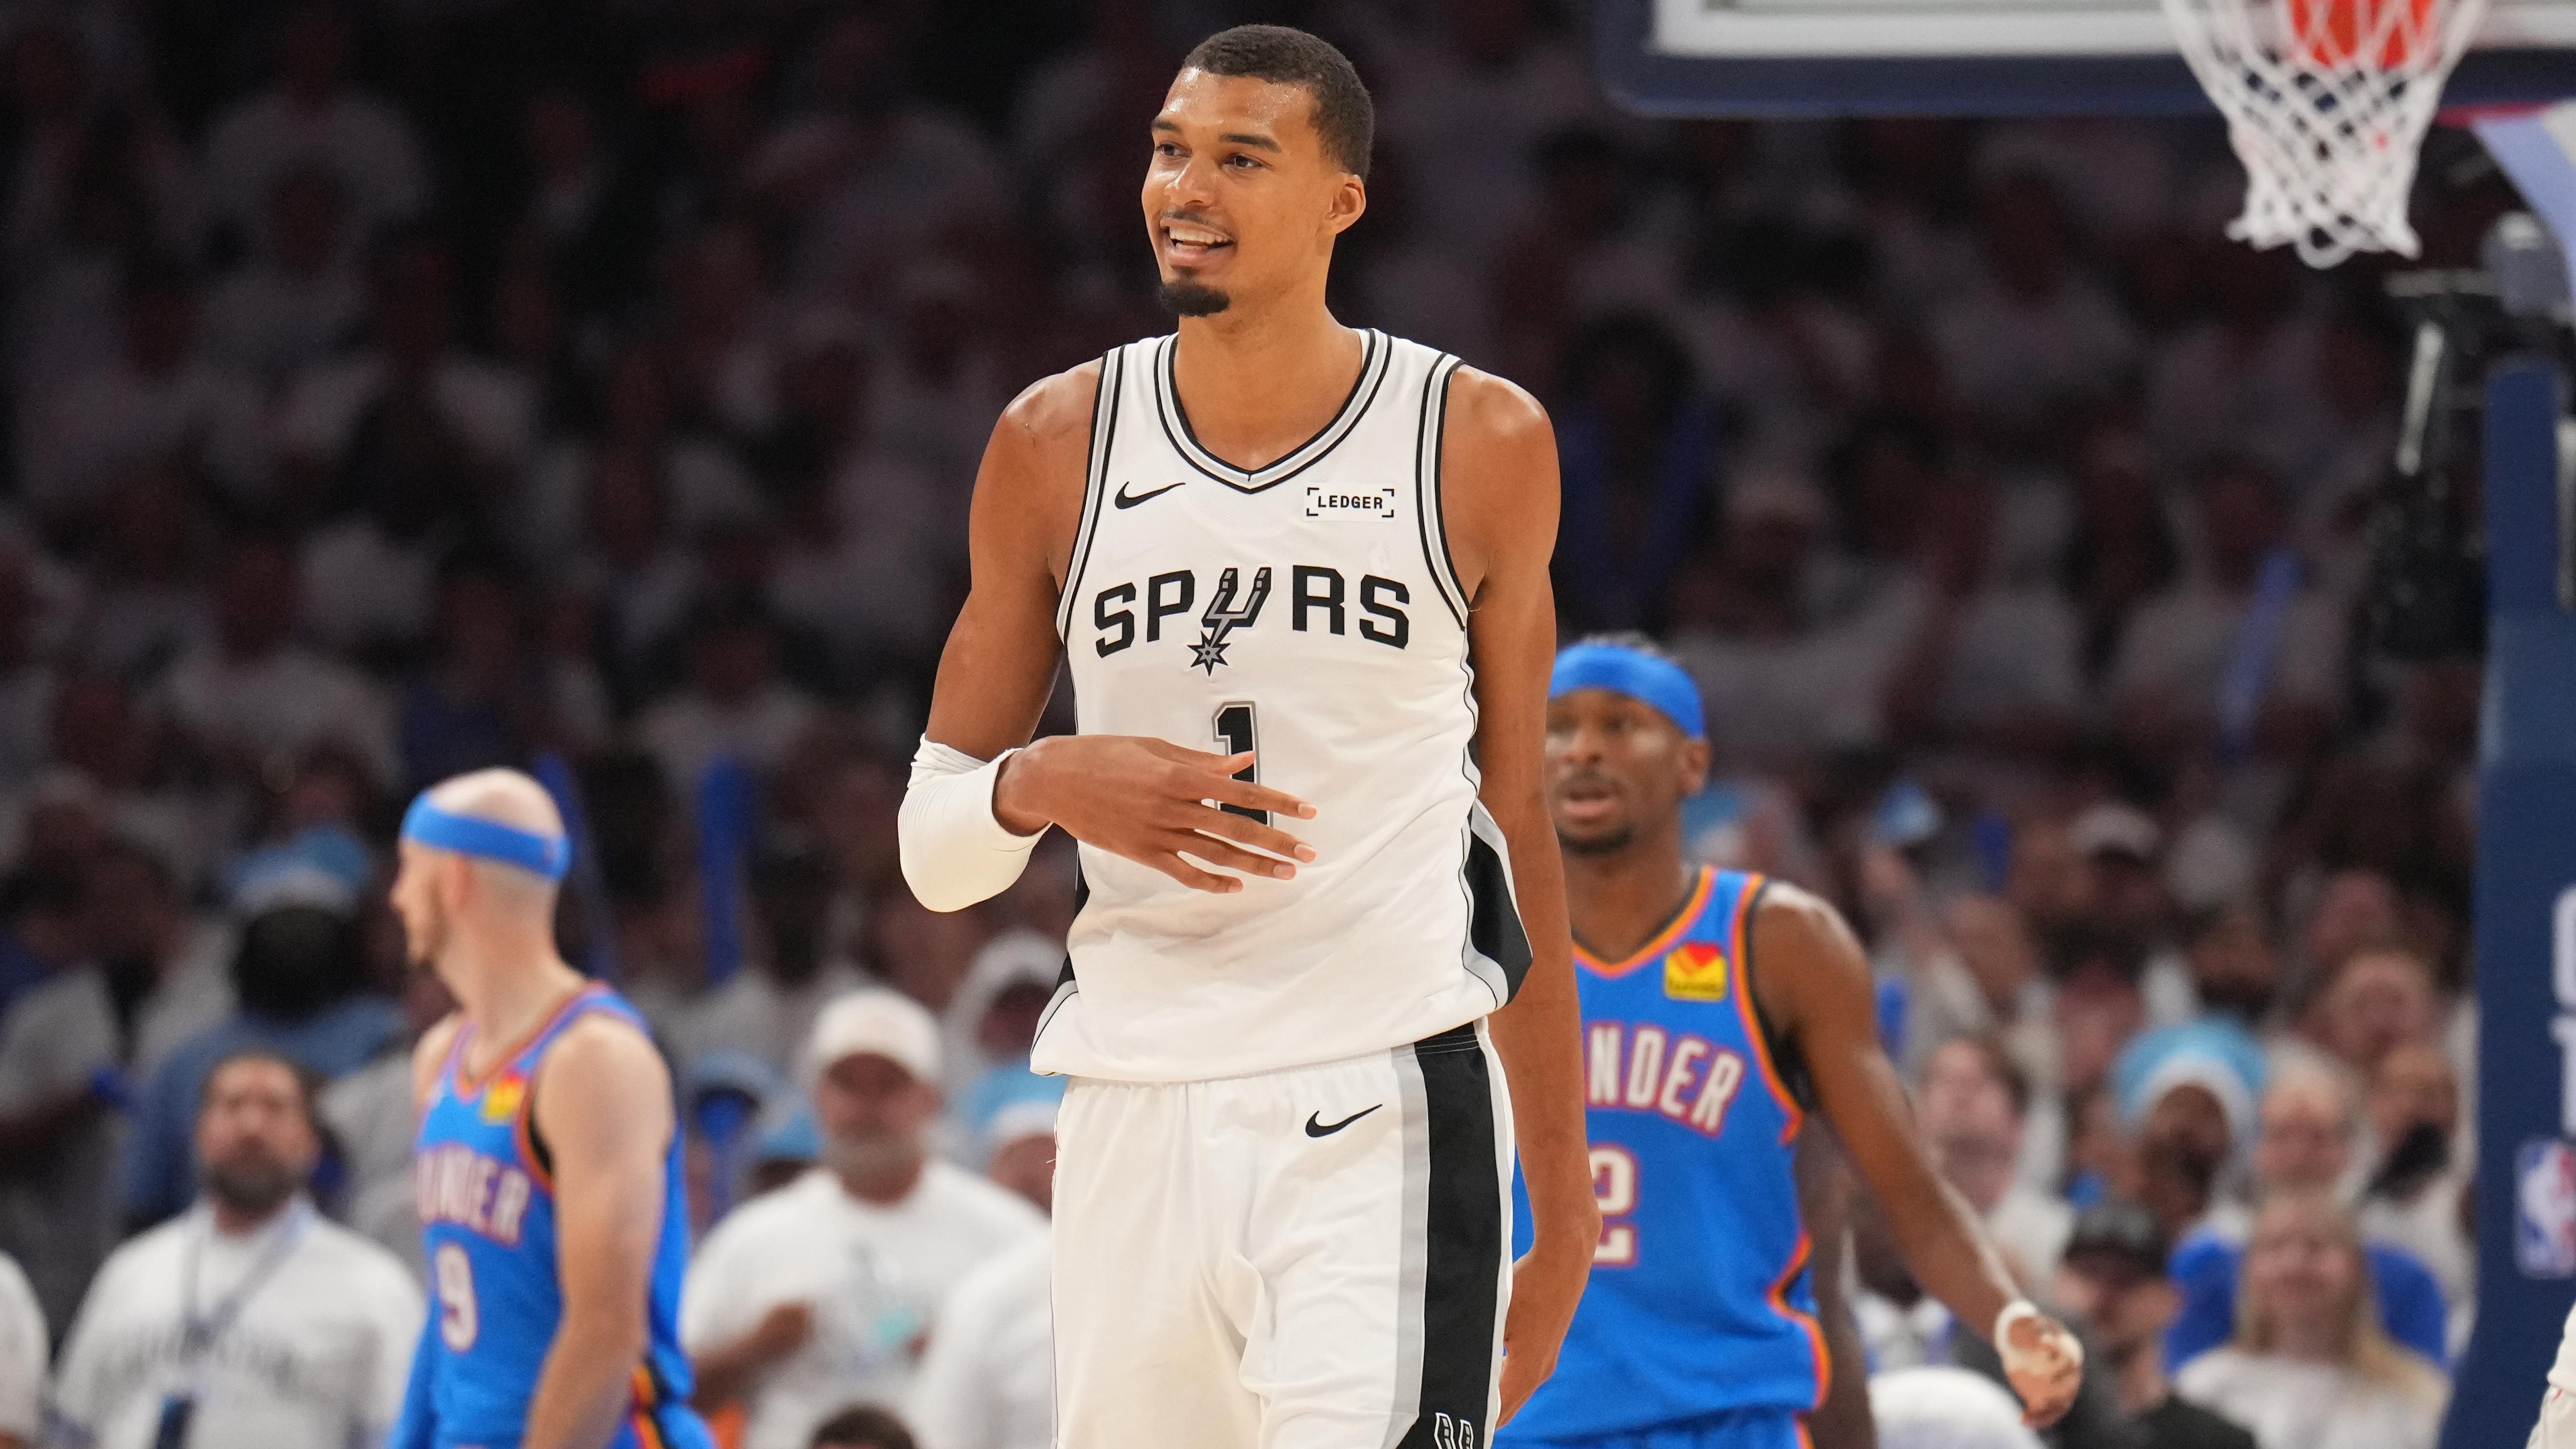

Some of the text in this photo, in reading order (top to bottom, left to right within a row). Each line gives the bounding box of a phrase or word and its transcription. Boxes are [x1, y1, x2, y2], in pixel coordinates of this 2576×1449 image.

[1317, 495, 1383, 509] LEDGER
[1094, 564, 1410, 677] SPURS
[1212, 701, 1273, 828] 1
[1585, 1022, 1743, 1136] NDER
[1589, 1145, 1636, 1263] 2
[435, 1241, 478, 1352] 9
